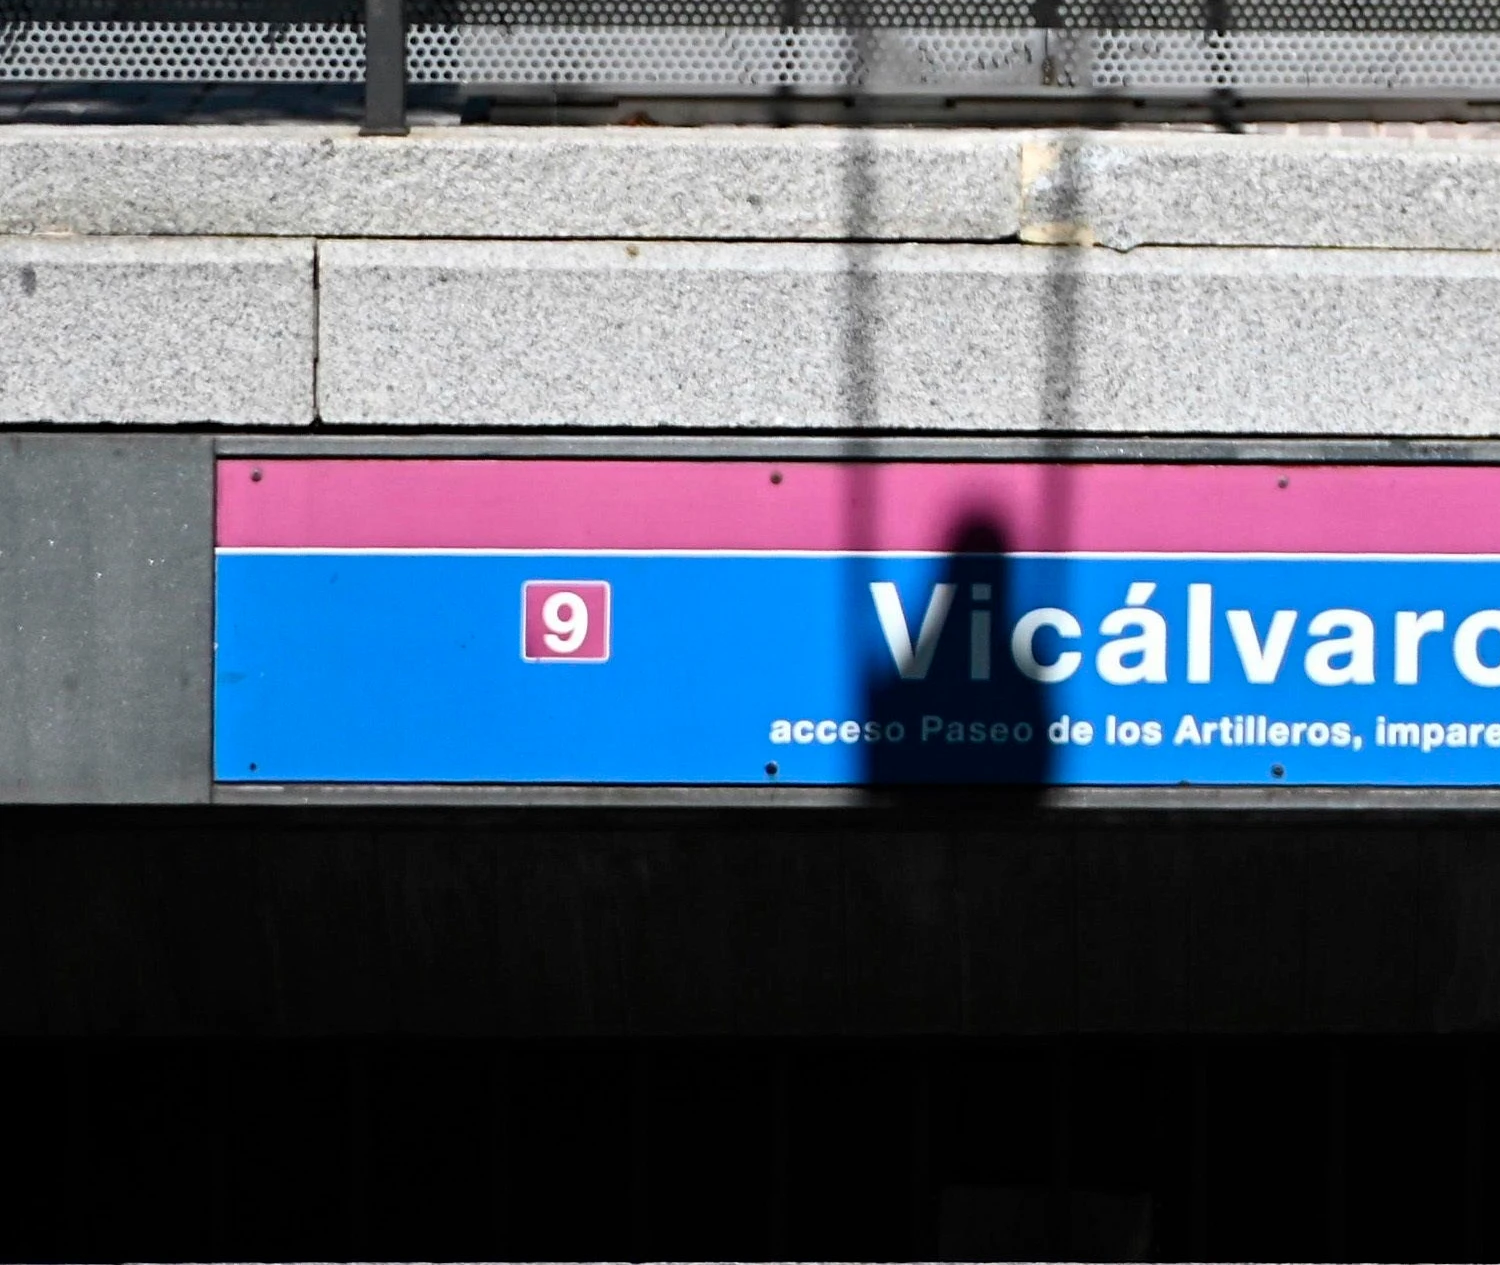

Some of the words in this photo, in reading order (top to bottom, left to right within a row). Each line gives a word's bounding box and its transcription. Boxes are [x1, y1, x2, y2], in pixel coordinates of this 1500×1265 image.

[541, 591, 589, 653] 9
[769, 718, 904, 746] acceso
[921, 714, 1034, 745] Paseo
[1048, 715, 1094, 746] de
[1105, 714, 1163, 746] los
[1173, 714, 1364, 752] Artilleros,
